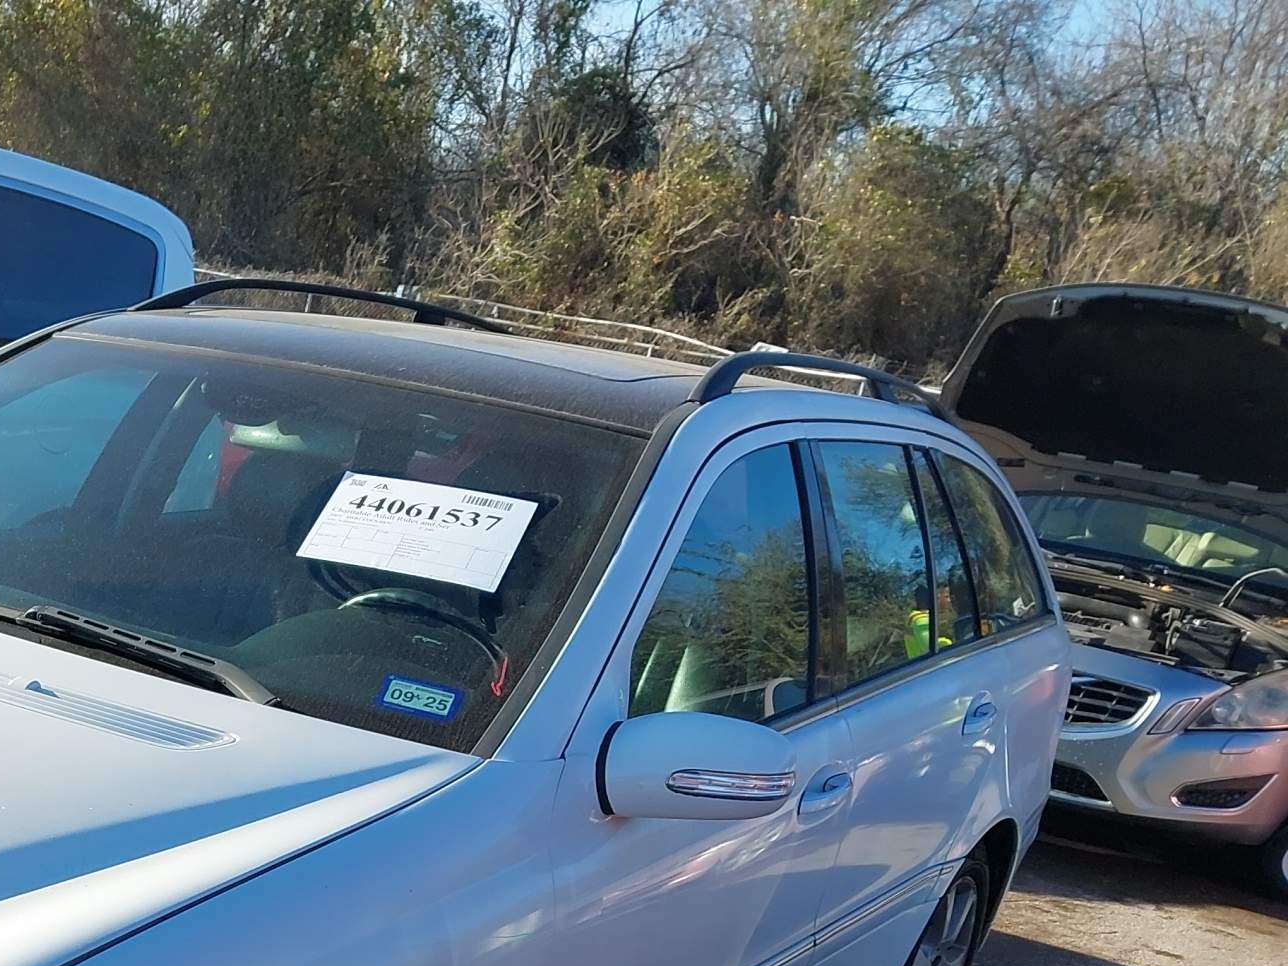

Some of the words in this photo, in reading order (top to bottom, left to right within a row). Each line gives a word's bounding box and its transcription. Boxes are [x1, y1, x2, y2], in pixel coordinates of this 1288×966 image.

[349, 494, 504, 531] 44061537
[390, 688, 415, 703] 09
[423, 696, 450, 712] 25
